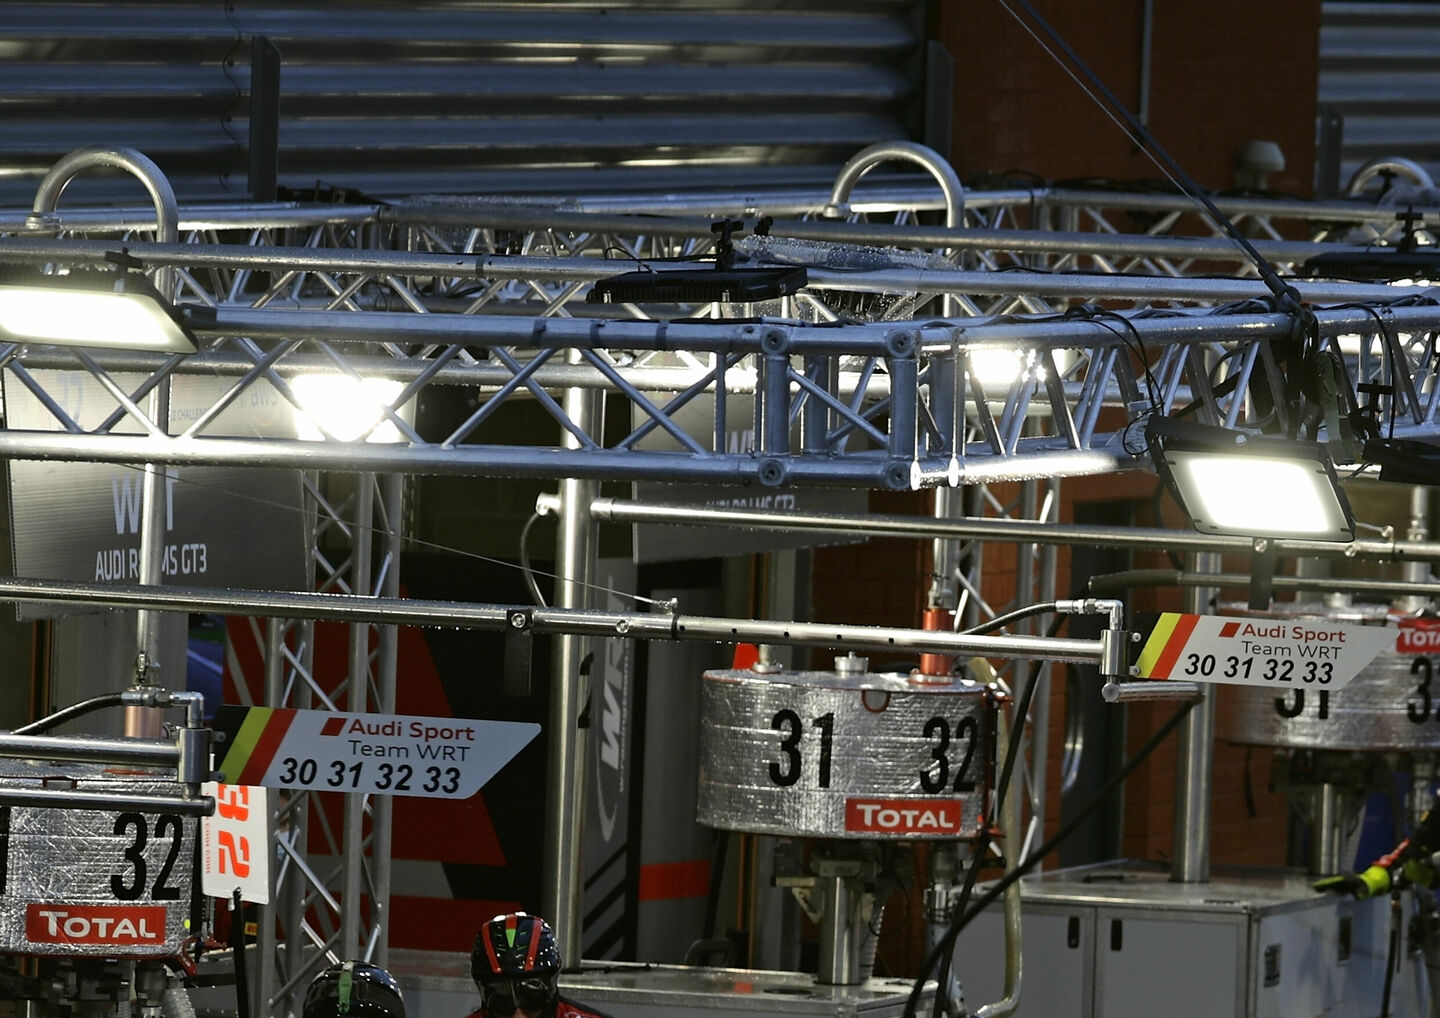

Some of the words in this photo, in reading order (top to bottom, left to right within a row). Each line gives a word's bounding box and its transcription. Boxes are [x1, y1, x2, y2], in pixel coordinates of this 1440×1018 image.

[111, 470, 179, 534] WT
[95, 550, 126, 580] AUDI
[181, 543, 207, 574] GT3
[1242, 622, 1286, 641] Audi
[1292, 625, 1346, 644] Sport
[1241, 640, 1291, 656] Team
[1297, 642, 1342, 660] WRT
[1184, 653, 1216, 676] 30
[1223, 655, 1255, 679] 31
[1263, 657, 1294, 682] 32
[1302, 660, 1334, 684] 33
[348, 718, 402, 738] Audi
[409, 722, 476, 743] Sport
[348, 739, 409, 759] Team
[416, 743, 471, 762] WRT
[768, 708, 835, 789] 31
[920, 716, 979, 794] 32
[279, 757, 318, 786] 30
[327, 760, 364, 788] 31
[375, 762, 413, 791] 32
[423, 765, 461, 794] 33
[857, 803, 954, 830] TOTAL
[111, 812, 183, 901] 32
[39, 910, 156, 939] TOTAL
